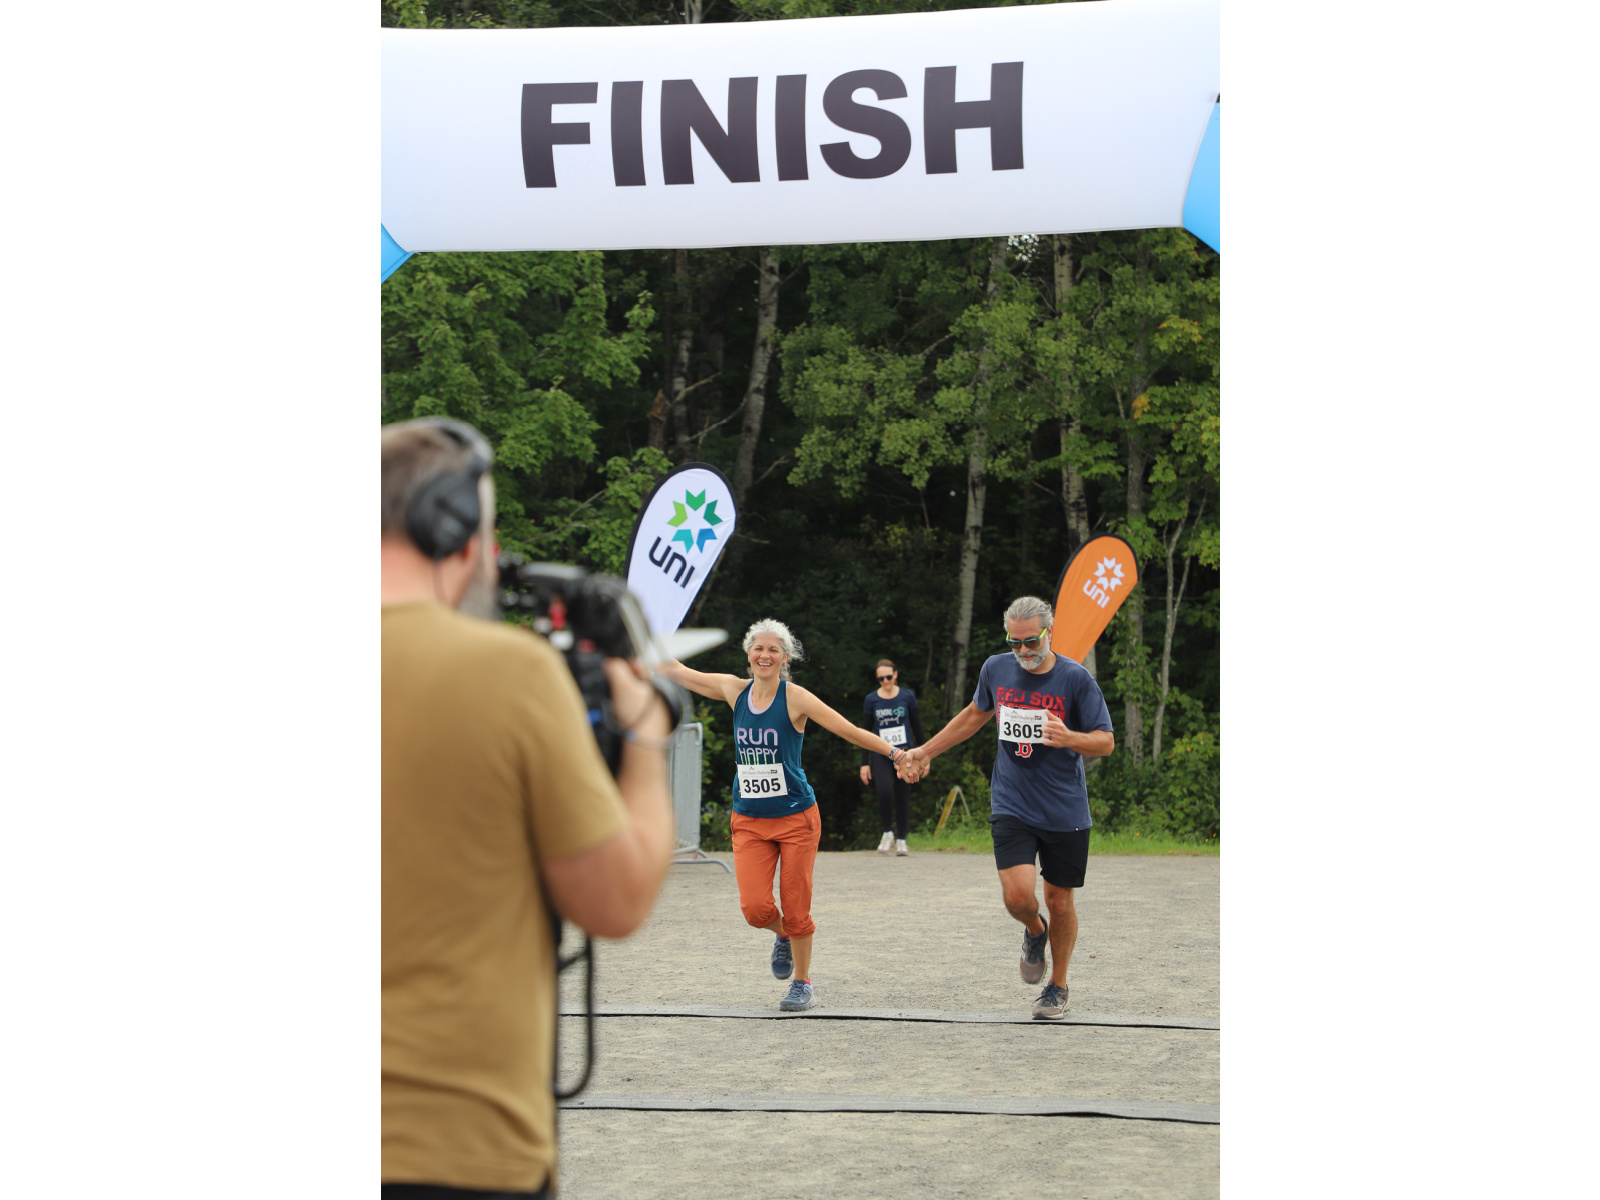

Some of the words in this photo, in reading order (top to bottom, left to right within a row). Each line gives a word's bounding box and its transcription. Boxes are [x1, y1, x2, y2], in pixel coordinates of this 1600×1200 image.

[520, 61, 1025, 189] FINISH
[649, 536, 696, 589] UNI
[1083, 579, 1111, 609] UNI
[996, 686, 1026, 703] RED
[1029, 692, 1065, 710] SOX
[737, 727, 778, 746] RUN
[1003, 722, 1043, 738] 3605
[738, 747, 778, 765] HAPPY
[743, 778, 781, 793] 3505
